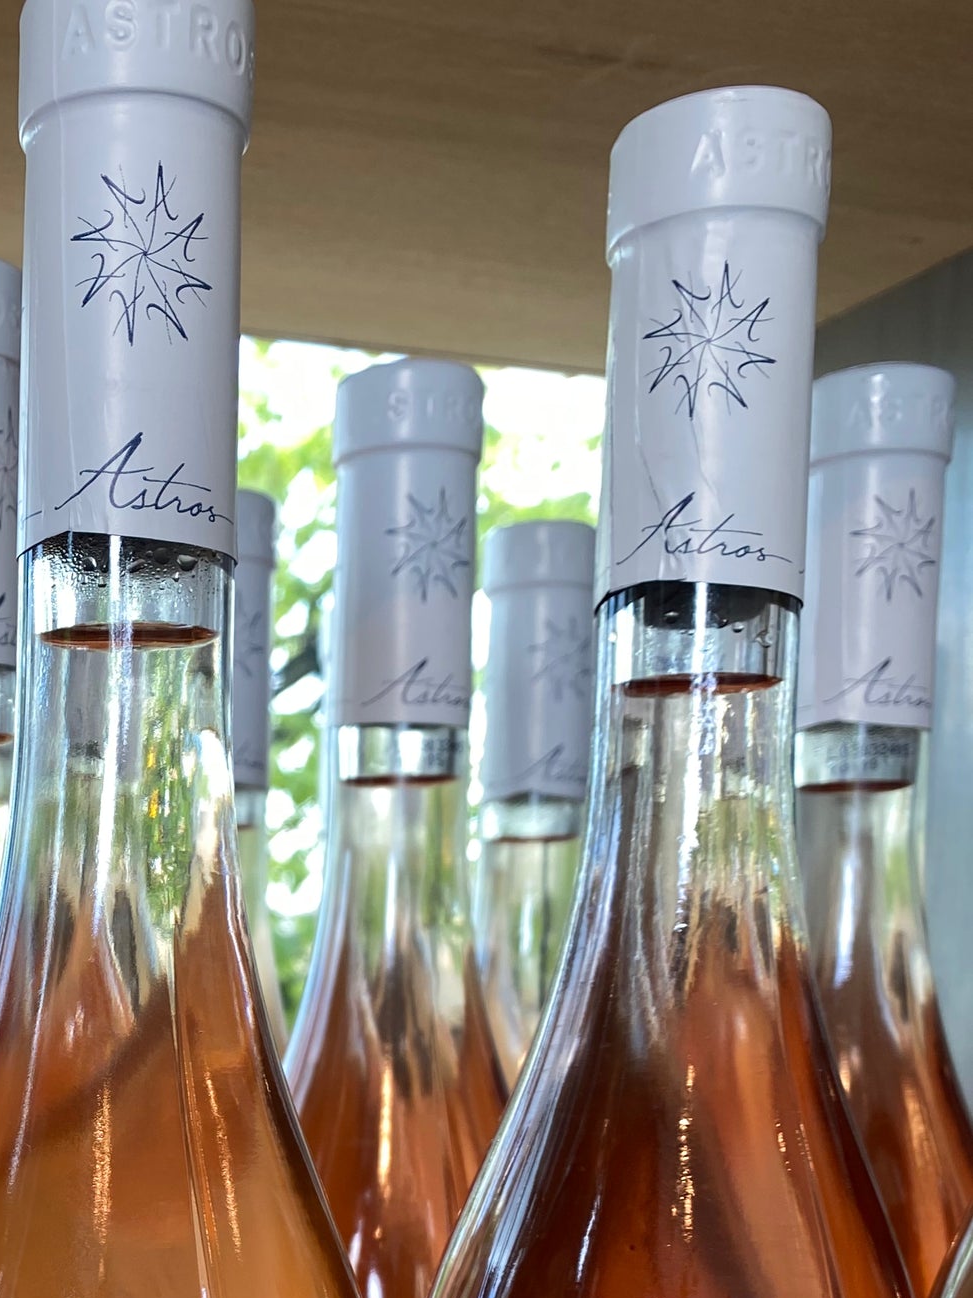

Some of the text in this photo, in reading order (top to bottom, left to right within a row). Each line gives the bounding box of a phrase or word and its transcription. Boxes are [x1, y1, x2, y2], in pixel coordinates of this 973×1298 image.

[690, 128, 831, 190] ASTR
[55, 432, 234, 523] Astros
[616, 491, 793, 564] Astros
